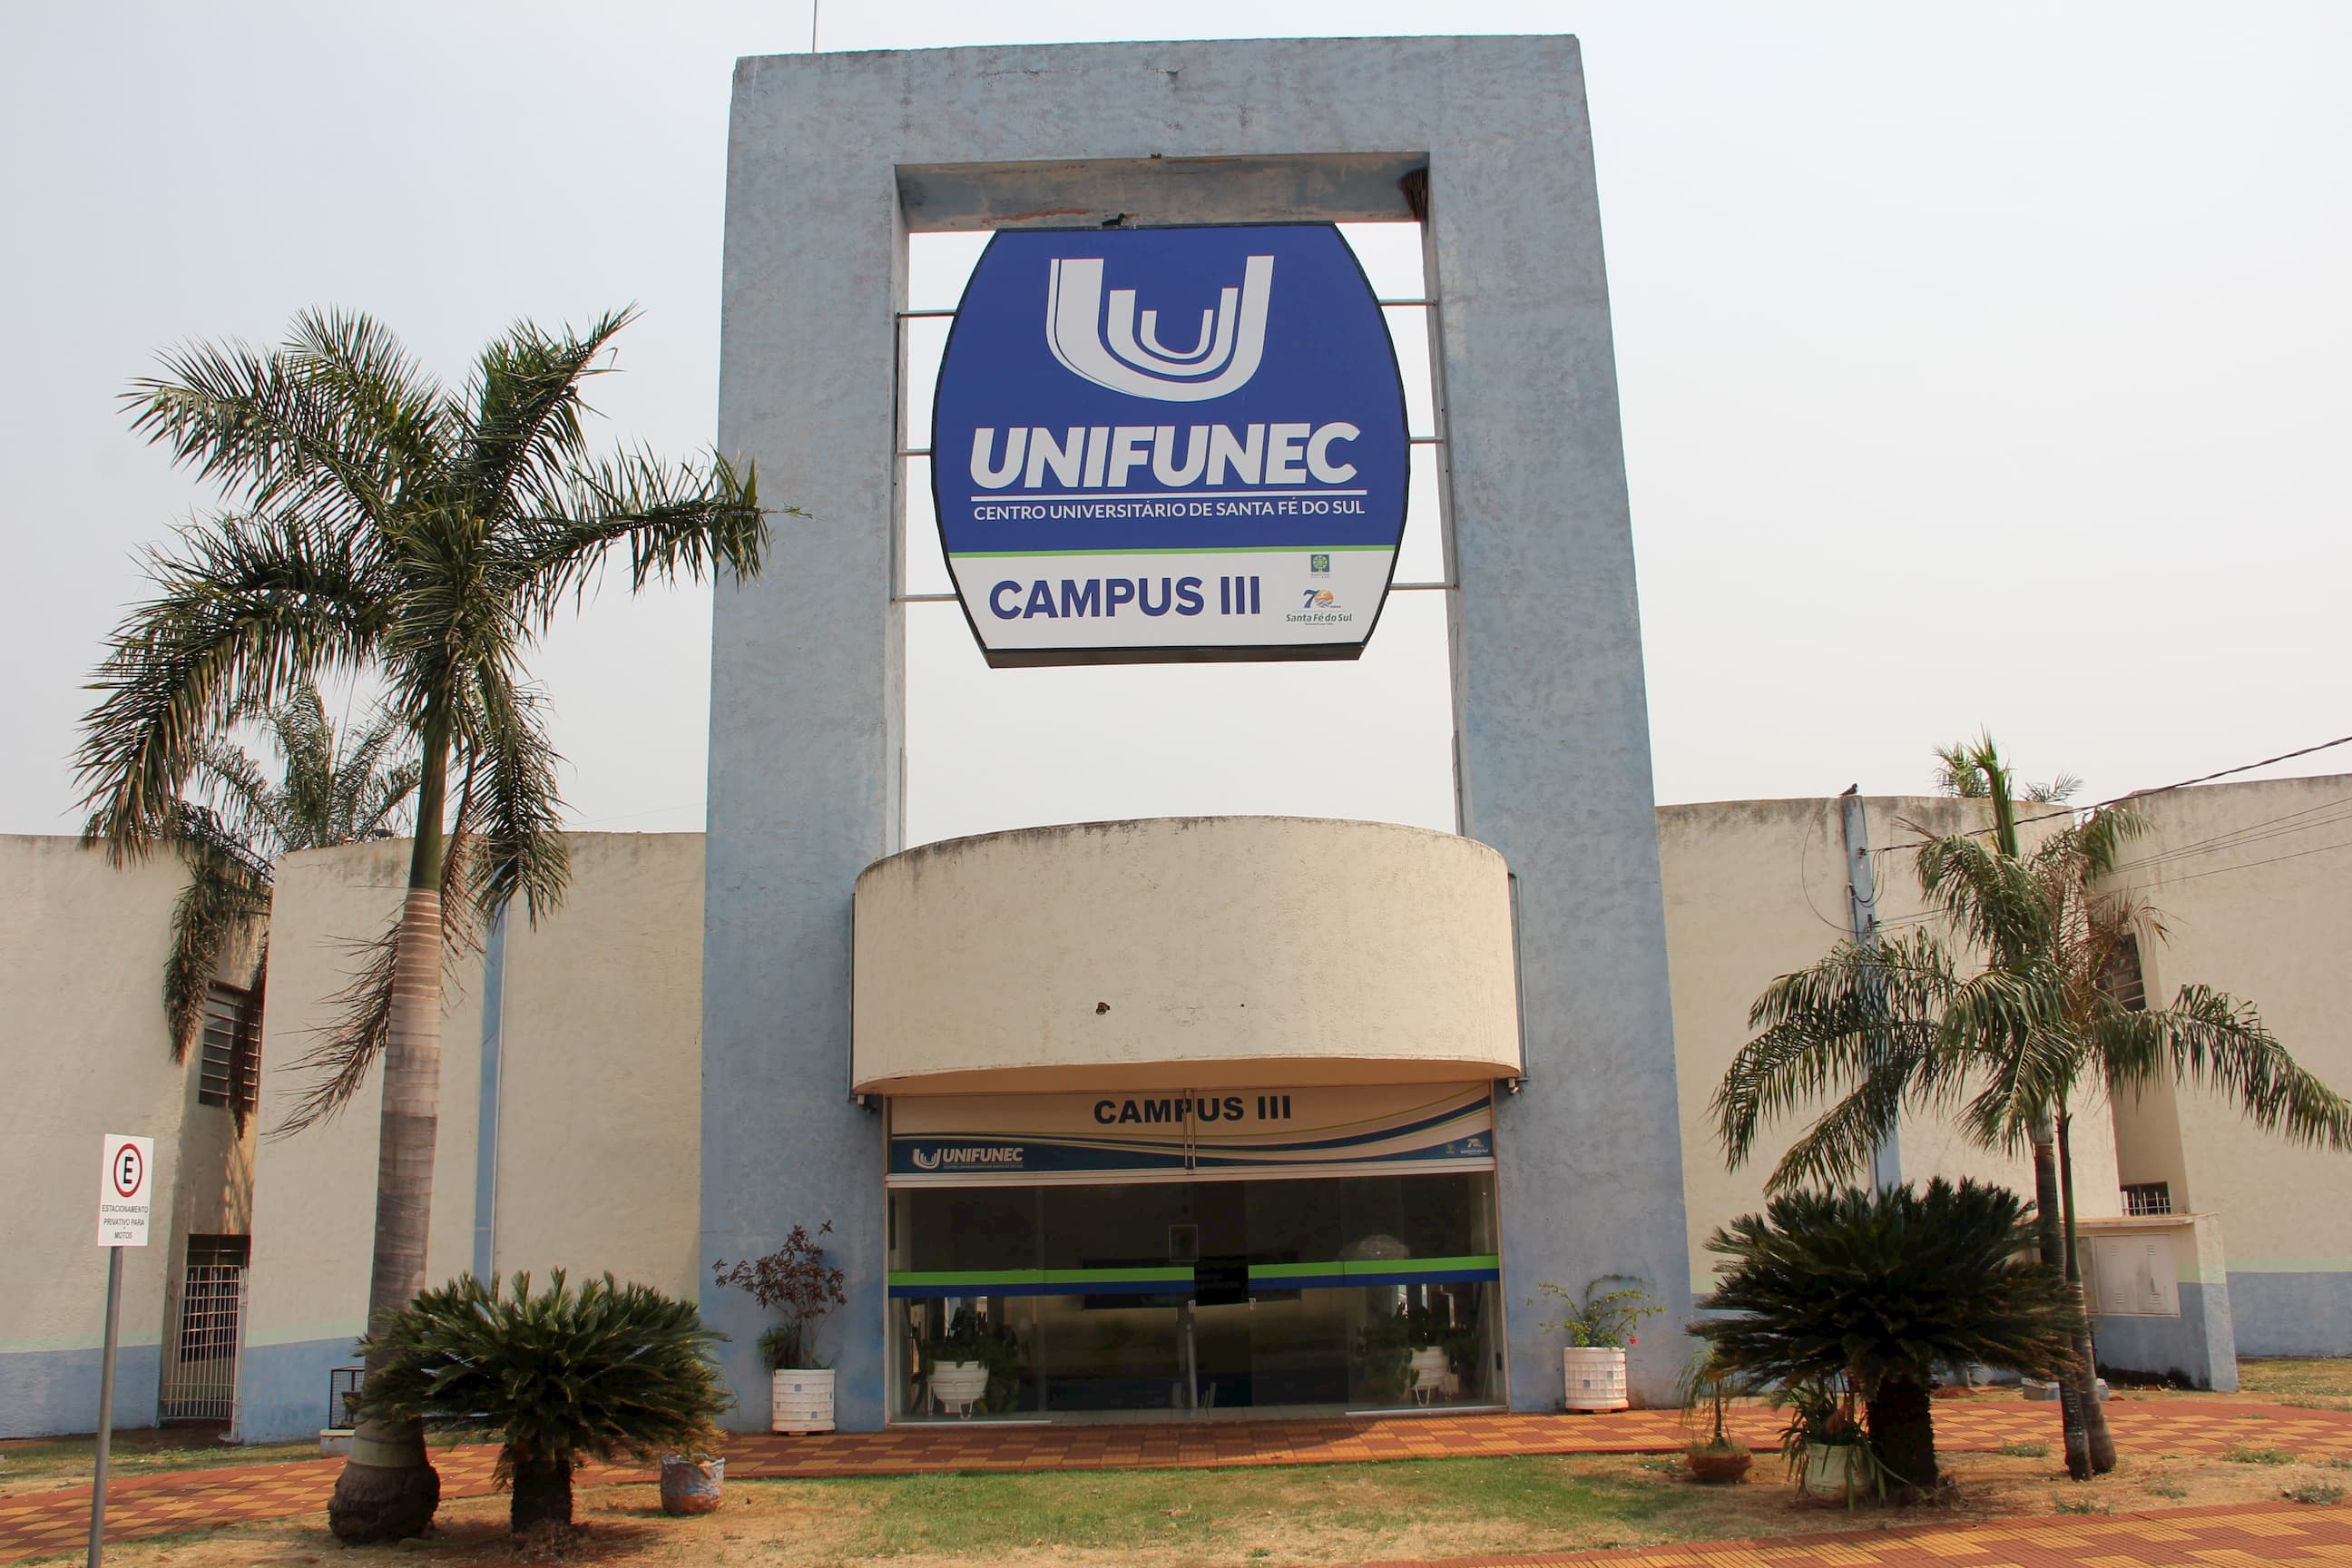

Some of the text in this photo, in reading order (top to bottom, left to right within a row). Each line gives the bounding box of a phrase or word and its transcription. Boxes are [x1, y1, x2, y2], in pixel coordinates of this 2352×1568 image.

[970, 421, 1361, 489] UNIFUNEC
[974, 496, 1366, 520] CENTRO UNIVERSITÁRIO DE SANTA FÉ DO SUL
[988, 575, 1261, 619] CAMPUS III
[1286, 613, 1312, 622] Santa
[1325, 613, 1337, 622] do
[1338, 613, 1352, 622] Sul
[1093, 1095, 1291, 1124] CAMPUS III
[942, 1147, 1024, 1162] UNIFUNEC
[102, 1205, 149, 1213] ESTACIONAMENTO
